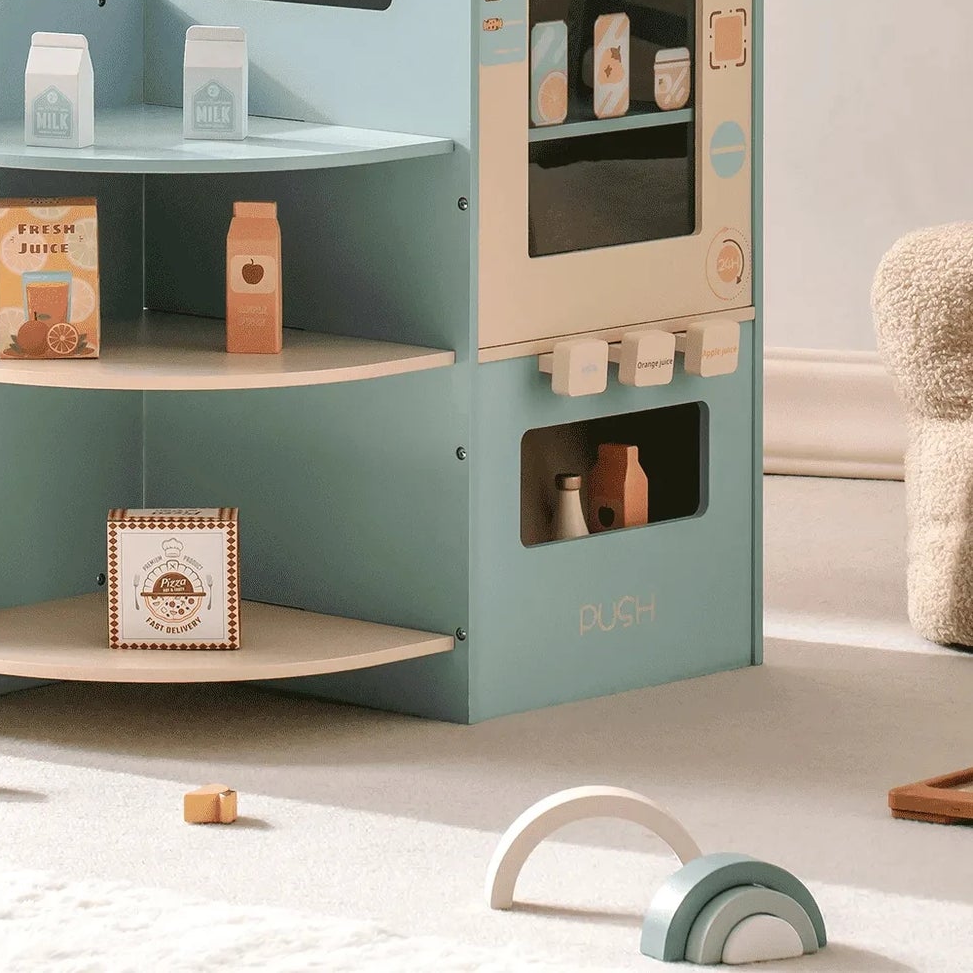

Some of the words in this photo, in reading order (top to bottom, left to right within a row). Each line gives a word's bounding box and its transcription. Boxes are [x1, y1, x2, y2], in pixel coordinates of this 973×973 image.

[36, 112, 69, 129] MILK
[196, 106, 230, 124] MILK
[18, 223, 75, 235] FRESH
[18, 243, 69, 254] JUICE
[637, 360, 659, 370] Orange
[659, 358, 673, 368] juice
[160, 577, 187, 588] Pizza
[579, 593, 656, 636] PUSH
[145, 616, 165, 631] FAST
[166, 616, 202, 634] DELIVERY
